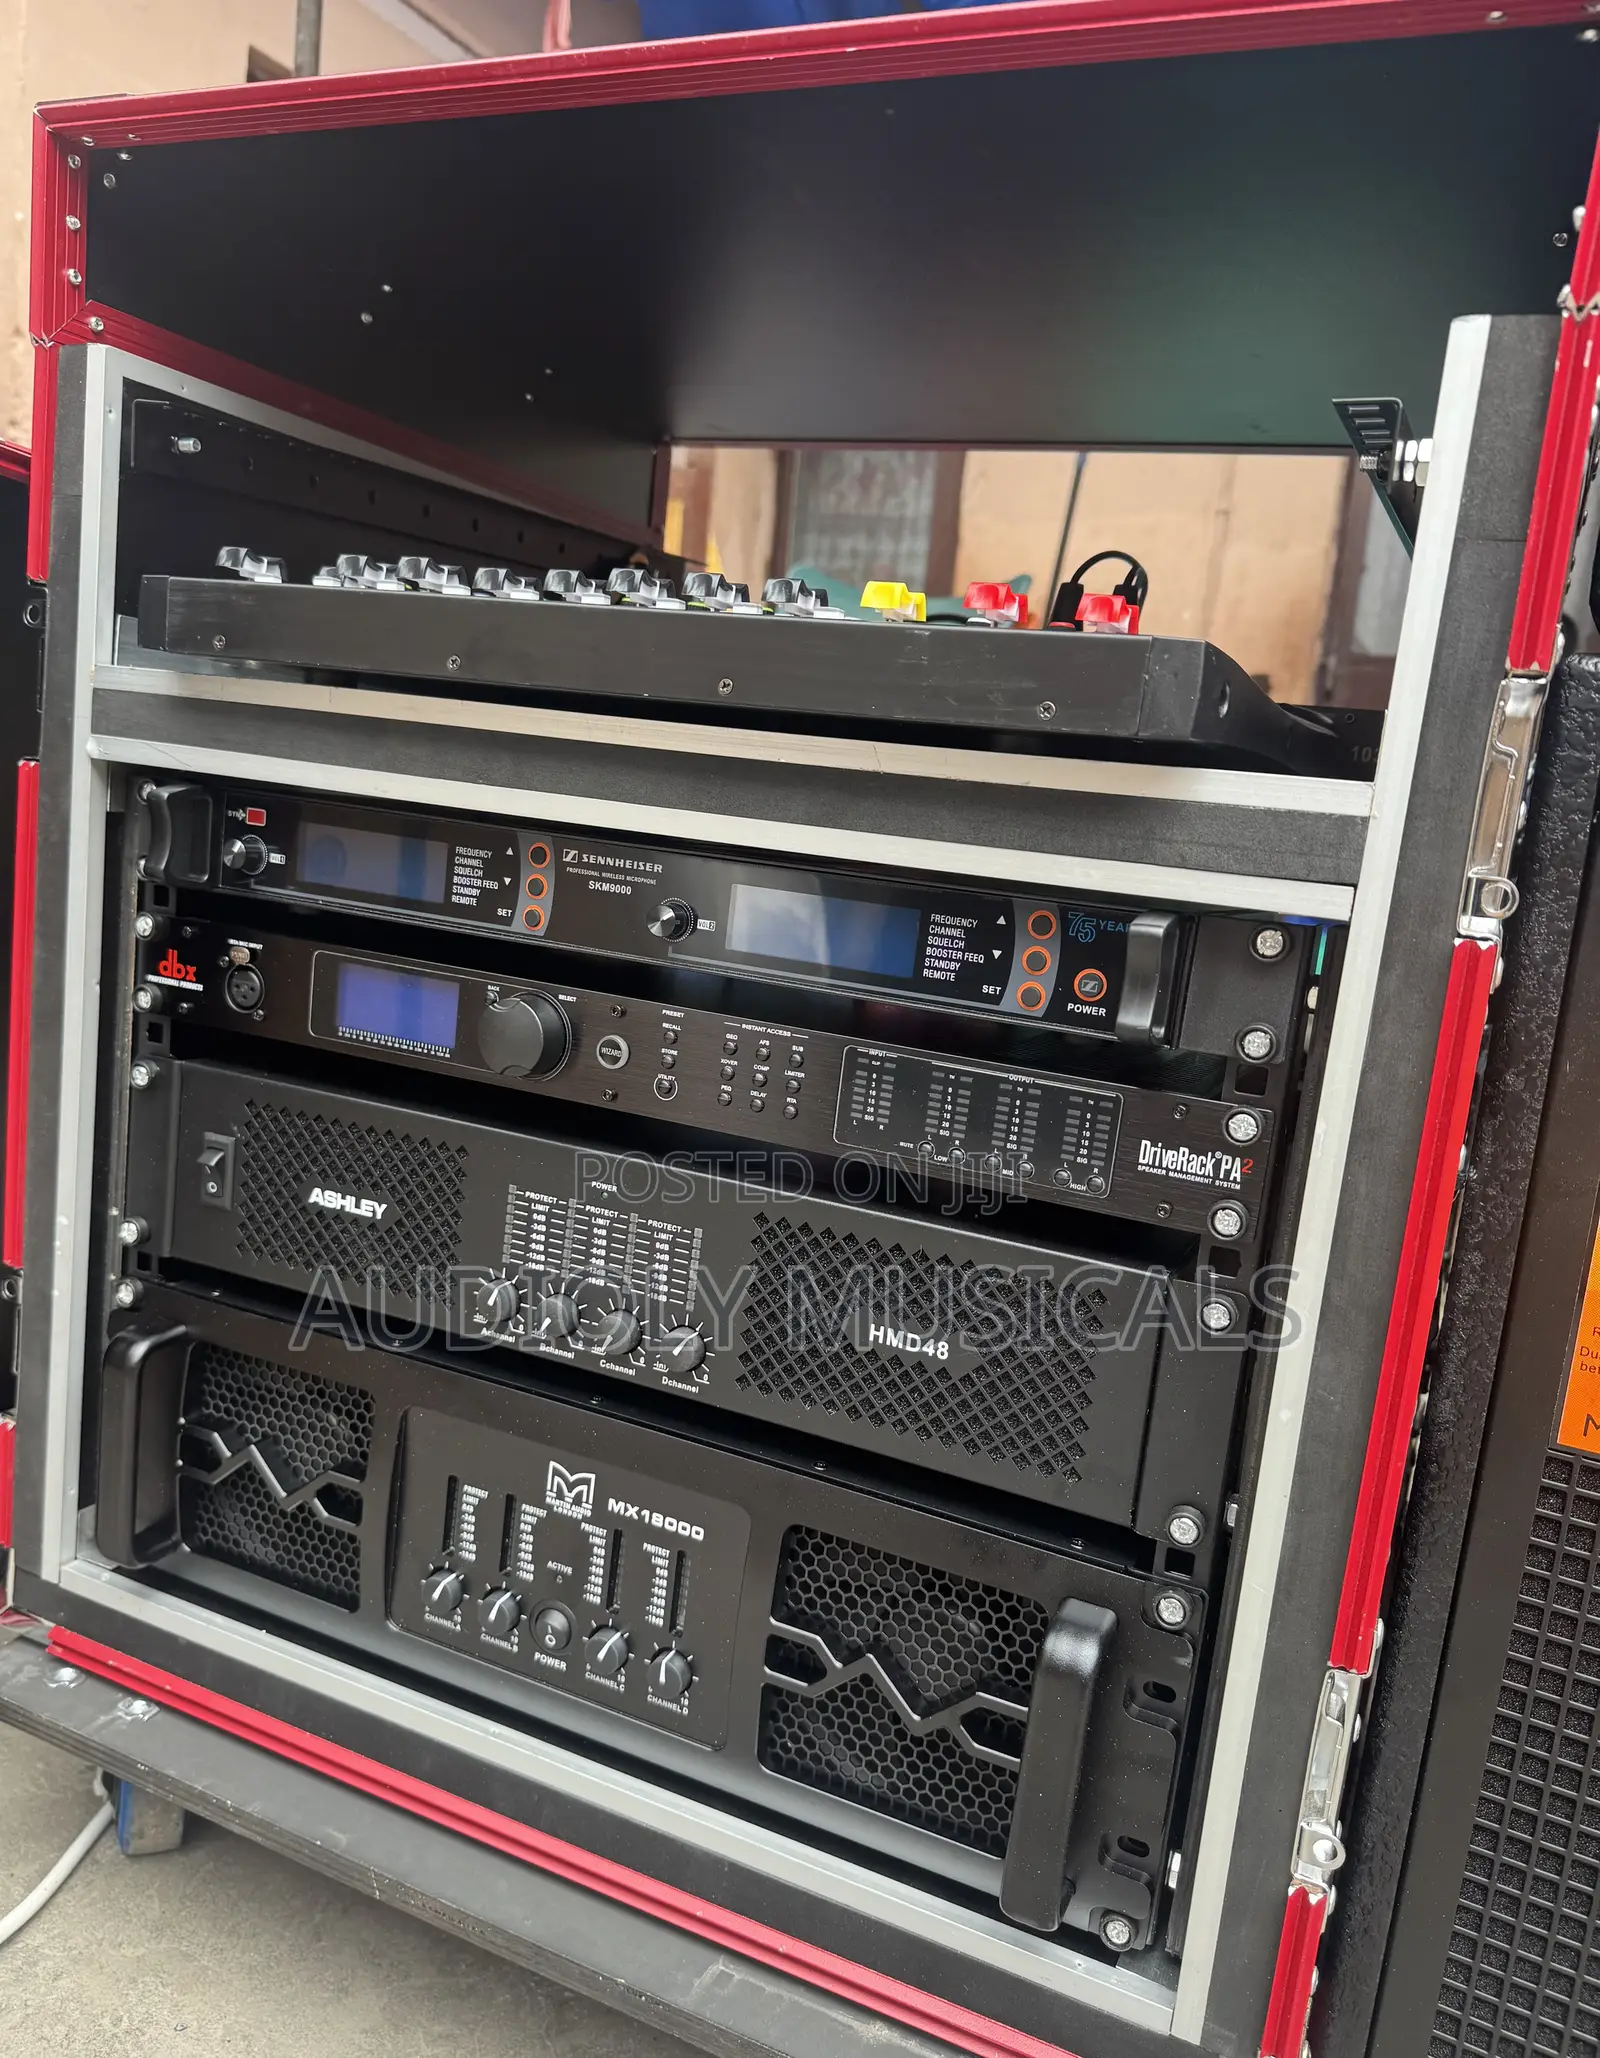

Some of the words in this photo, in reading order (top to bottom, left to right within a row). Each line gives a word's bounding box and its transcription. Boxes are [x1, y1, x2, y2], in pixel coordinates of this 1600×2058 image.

[456, 846, 492, 858] FREQUENCY
[455, 856, 483, 867] CHANNEL
[582, 854, 663, 873] SENNHEISER
[454, 866, 483, 877] SQUELCH
[566, 867, 600, 876] PROFESSIONAL
[602, 872, 624, 880] WIRELESS
[626, 875, 656, 885] MICROPHONE
[453, 876, 481, 887] BOOSTER
[452, 886, 480, 896] STANDBY
[589, 881, 632, 895] SKM9000
[452, 895, 477, 906] REMOTE
[497, 908, 512, 917] SET
[930, 914, 978, 928] FREQUENCY
[1068, 912, 1096, 942] 75
[929, 925, 966, 938] CHANNEL
[928, 936, 964, 949] SQUELCH
[926, 947, 962, 960] BOOSTER
[964, 952, 984, 963] FEEQ
[159, 949, 196, 981] dbx
[925, 958, 960, 970] STANDBY
[923, 969, 955, 981] REMOTE
[982, 985, 1001, 994] SET
[662, 1009, 685, 1017] PRESET
[1067, 1003, 1106, 1016] POWER
[742, 1024, 766, 1032] INSTANT
[601, 1047, 621, 1057] WIZARD
[869, 1049, 885, 1057] INPUT
[784, 1070, 805, 1078] LIMITER
[1009, 1075, 1034, 1083] OUTPUT
[1138, 1165, 1166, 1175] SPEAKER
[1169, 1171, 1212, 1184] MANAGEMENT
[1215, 1180, 1240, 1190] SYSTEM
[592, 1181, 618, 1193] POWER
[1070, 1183, 1086, 1191] HIGH
[525, 1191, 557, 1203] PROTECT
[308, 1187, 388, 1220] ASHLEY
[531, 1203, 550, 1212] LIMIT
[533, 1213, 546, 1221] 0dB
[586, 1205, 618, 1218] PROTECT
[531, 1223, 546, 1231] -3dB
[592, 1217, 610, 1226] LIMIT
[648, 1220, 682, 1232] PROTECT
[593, 1227, 607, 1236] 0dB
[654, 1231, 673, 1241] LIMIT
[591, 1237, 607, 1246] -3dB
[656, 1242, 669, 1250] 0dB
[526, 1252, 545, 1261] -12dB
[654, 1253, 669, 1261] -3dB
[587, 1267, 605, 1276] -12dB
[649, 1283, 668, 1292] -12dB
[481, 1327, 515, 1343] Achannel
[869, 1324, 948, 1360] HMD48
[540, 1343, 574, 1359] Bchannel
[1579, 1346, 1600, 1360] Du
[600, 1359, 635, 1376] Cchannel
[662, 1376, 699, 1393] Dchannel
[463, 1485, 488, 1499] PROTECT
[462, 1494, 479, 1506] LIMIT
[522, 1504, 547, 1518] PROTECT
[546, 1497, 570, 1509] MARTIN
[571, 1504, 591, 1517] AUDIO
[554, 1505, 582, 1520] LONDON
[521, 1513, 537, 1525] LIMIT
[608, 1498, 704, 1541] MX18000
[581, 1522, 607, 1537] PROTECT
[589, 1535, 606, 1547] LIMIT
[643, 1542, 670, 1558] PROTECT
[652, 1555, 669, 1568] LIMIT
[547, 1560, 573, 1576] ACTIVE
[424, 1613, 455, 1629] CHANNEL
[480, 1633, 512, 1650] CHANNEL
[534, 1652, 567, 1671] POWER
[586, 1671, 618, 1689] CHANNEL
[620, 1684, 625, 1693] C
[618, 1674, 625, 1683] 10
[647, 1694, 681, 1712] CHANNEL
[683, 1707, 688, 1716] D
[681, 1697, 689, 1706] 10
